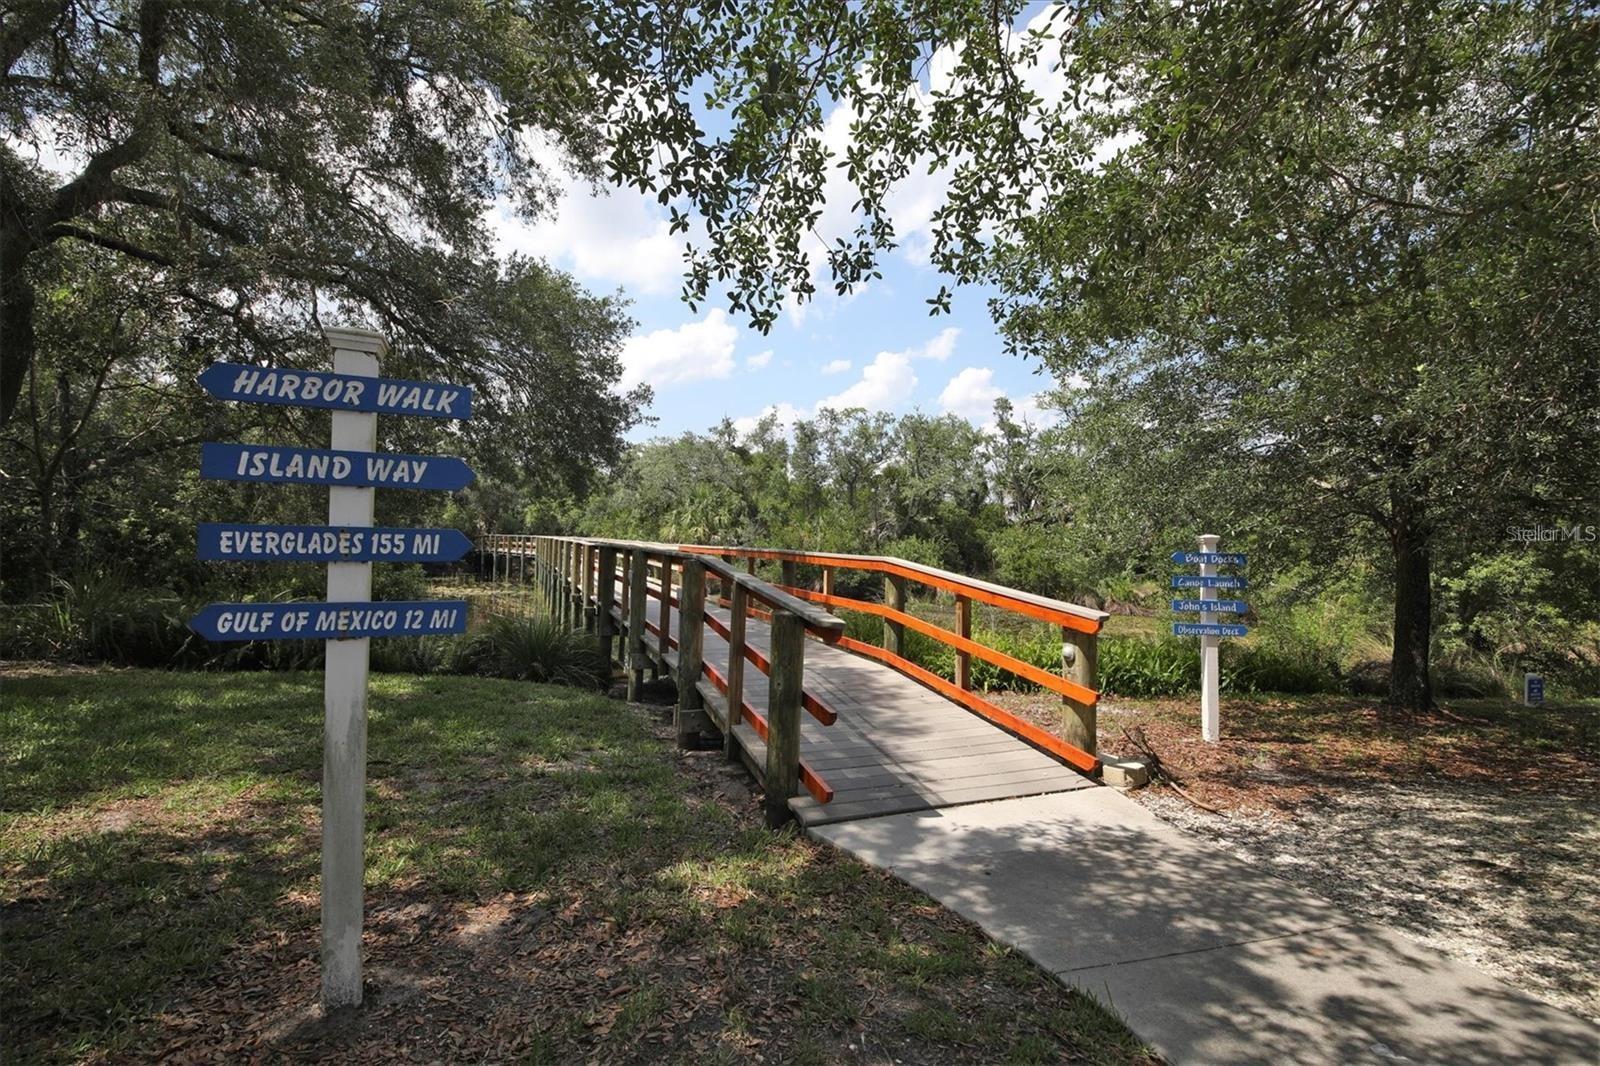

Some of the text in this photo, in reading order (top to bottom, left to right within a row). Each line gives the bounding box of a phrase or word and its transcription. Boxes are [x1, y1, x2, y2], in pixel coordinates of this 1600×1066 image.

[233, 370, 459, 413] HARBOR WALK
[236, 451, 428, 483] ISLAND WAY
[220, 531, 440, 556] EVERGLADES 155 MI
[1211, 554, 1239, 563] Docks
[1208, 578, 1240, 588] Launch
[1179, 602, 1237, 612] John's Island
[217, 609, 458, 633] GULF OF MEXICO 12 MI
[1178, 626, 1220, 635] Observation
